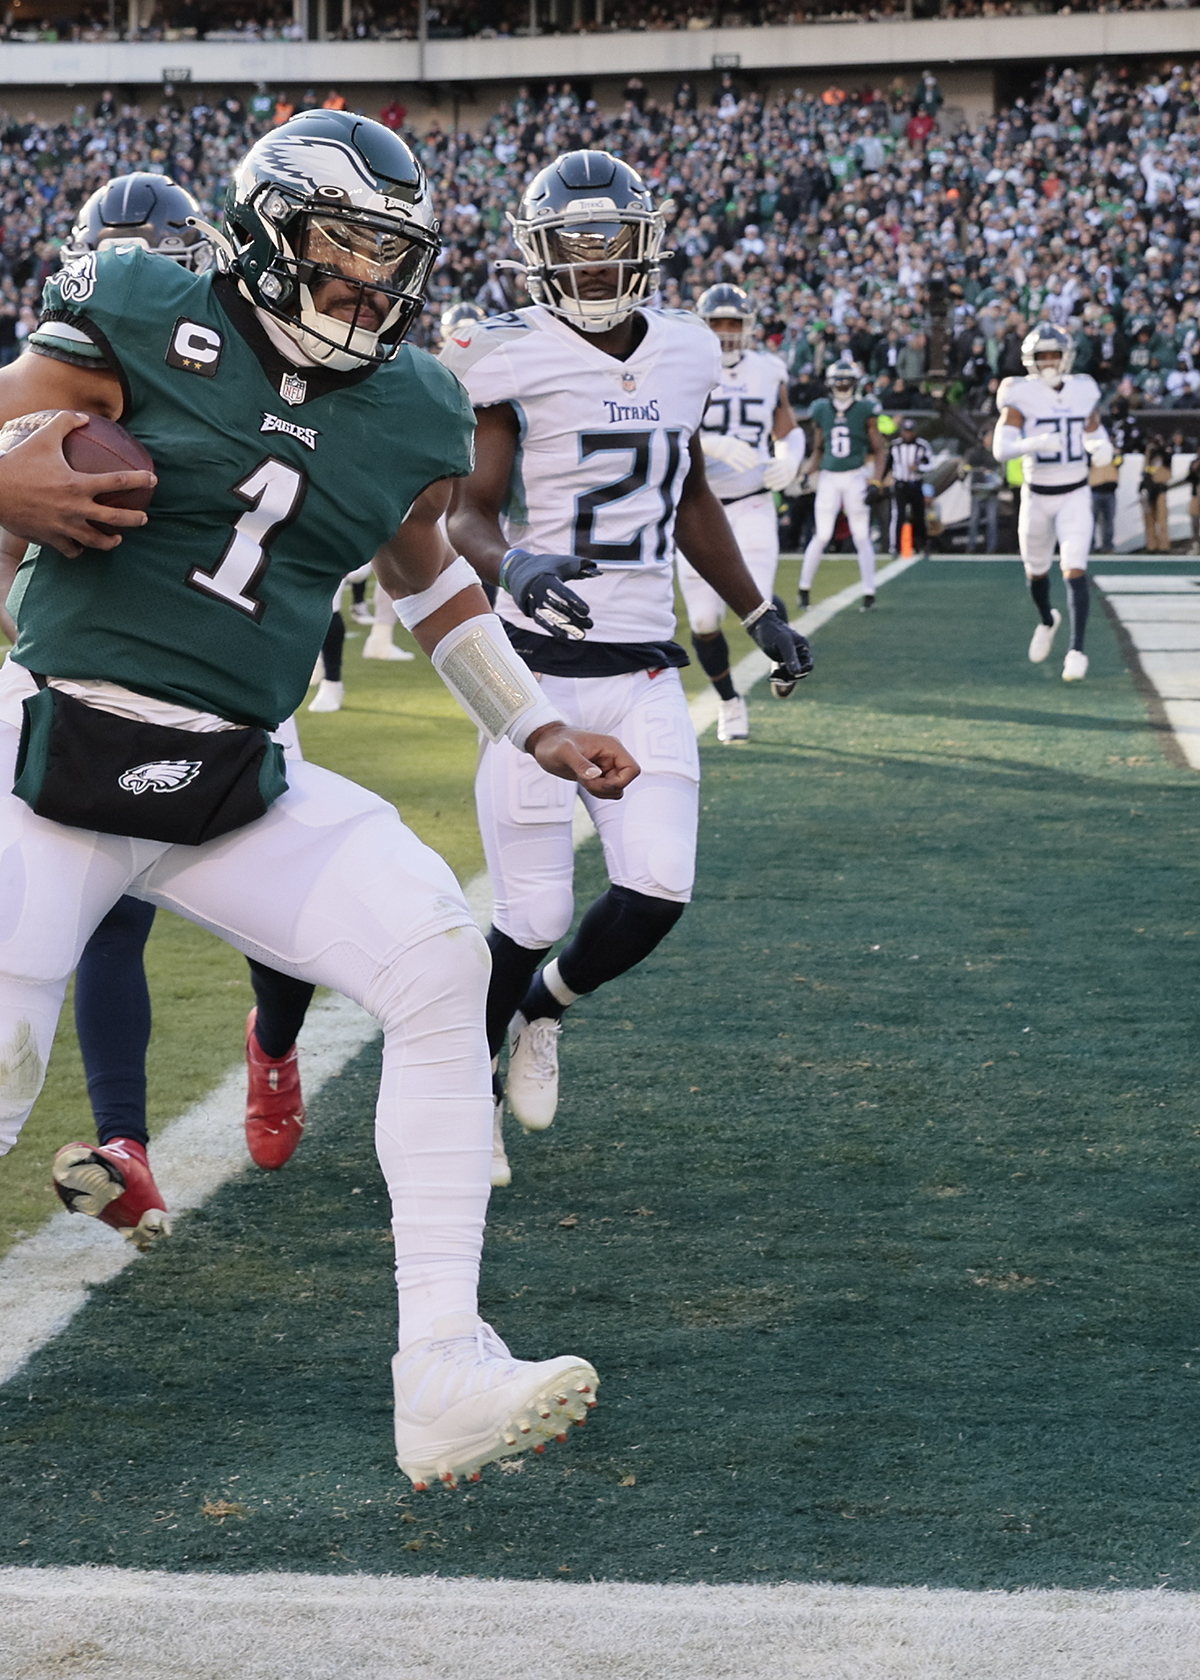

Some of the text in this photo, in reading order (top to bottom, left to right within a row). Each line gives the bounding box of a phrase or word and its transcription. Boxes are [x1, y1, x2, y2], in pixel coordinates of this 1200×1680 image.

[174, 322, 221, 364] C
[283, 385, 304, 400] NFL
[603, 399, 660, 423] TITANS
[260, 412, 318, 450] EAGLES
[831, 426, 851, 458] 6
[572, 429, 682, 564] 21
[188, 455, 304, 617] 1
